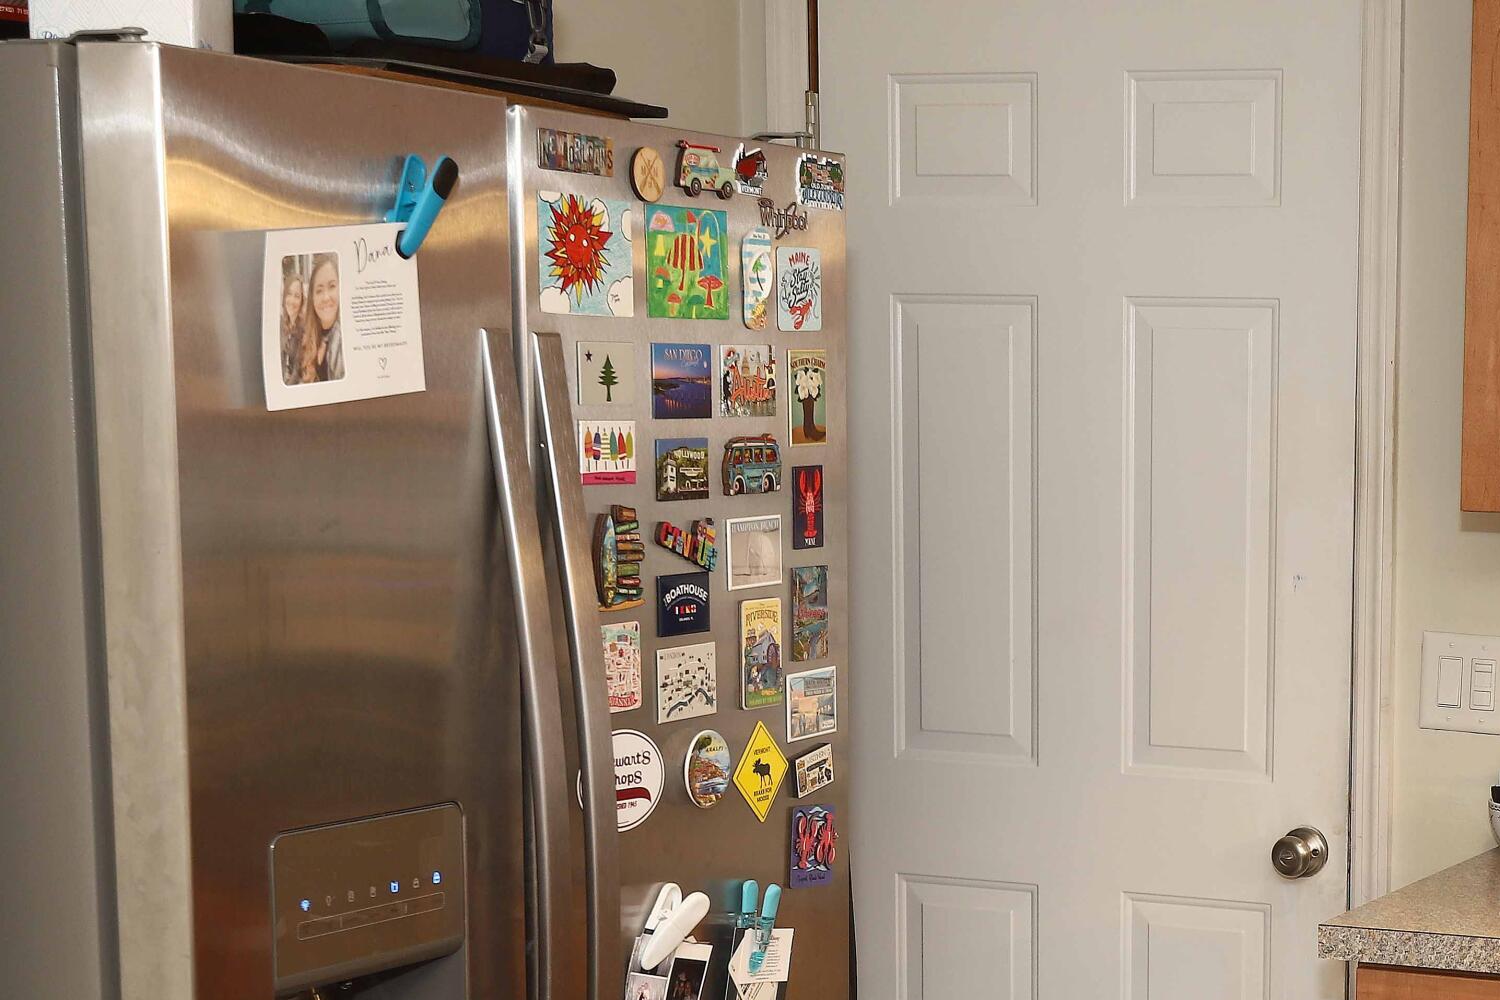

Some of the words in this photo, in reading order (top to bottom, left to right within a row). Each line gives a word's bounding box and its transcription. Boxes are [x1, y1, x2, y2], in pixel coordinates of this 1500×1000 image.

[740, 184, 763, 195] VERMONT
[759, 203, 809, 234] Whirlpool
[789, 252, 810, 267] MAINE
[790, 267, 810, 288] Stay
[789, 280, 812, 308] Salty
[664, 349, 678, 361] SAN
[679, 349, 703, 361] DIEGO
[665, 584, 708, 603] BOATHOUSE
[745, 609, 779, 626] RIVERSIDE
[753, 745, 771, 756] VERMONT
